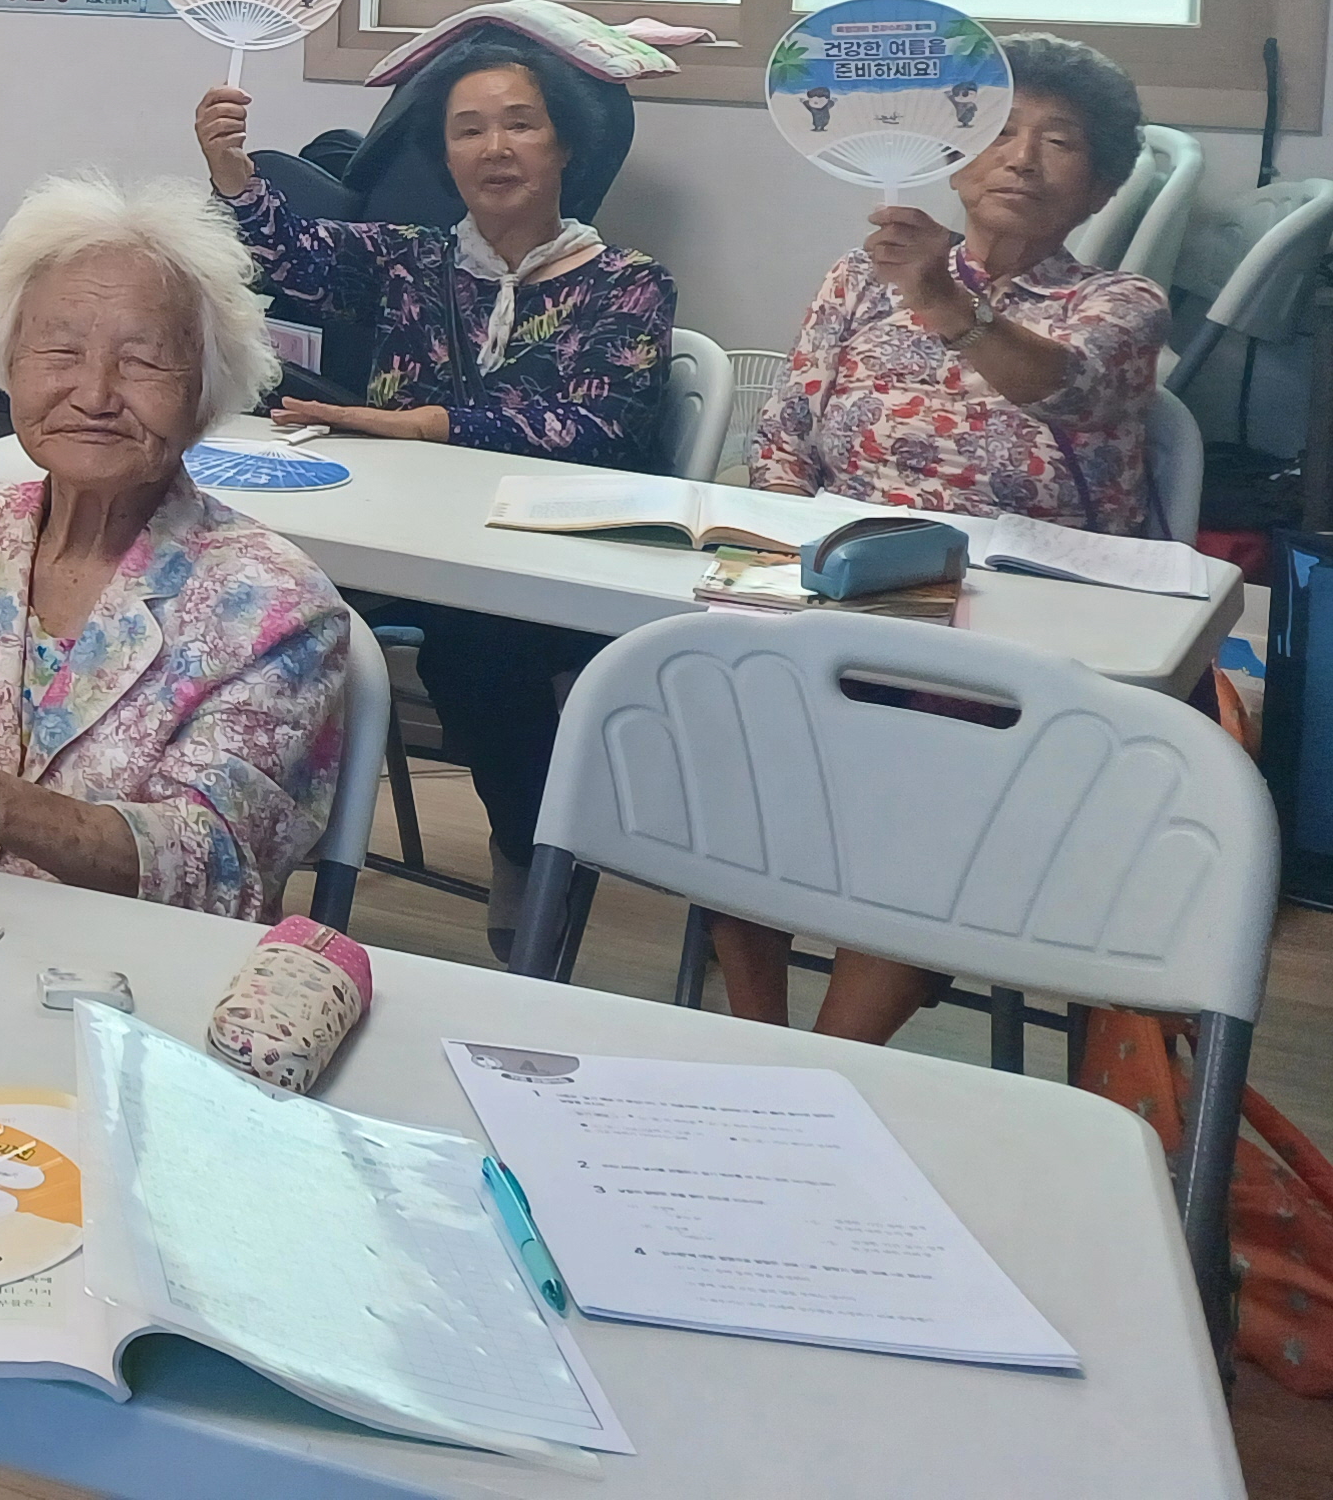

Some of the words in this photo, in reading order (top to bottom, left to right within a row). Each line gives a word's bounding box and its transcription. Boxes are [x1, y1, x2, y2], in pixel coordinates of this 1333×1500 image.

[824, 41, 881, 57] 건강한
[889, 39, 946, 55] 여름을
[835, 62, 937, 79] 준비하세요!
[533, 1089, 541, 1097] 1
[577, 1161, 589, 1169] 2
[593, 1185, 606, 1194] 3
[634, 1247, 646, 1255] 4
